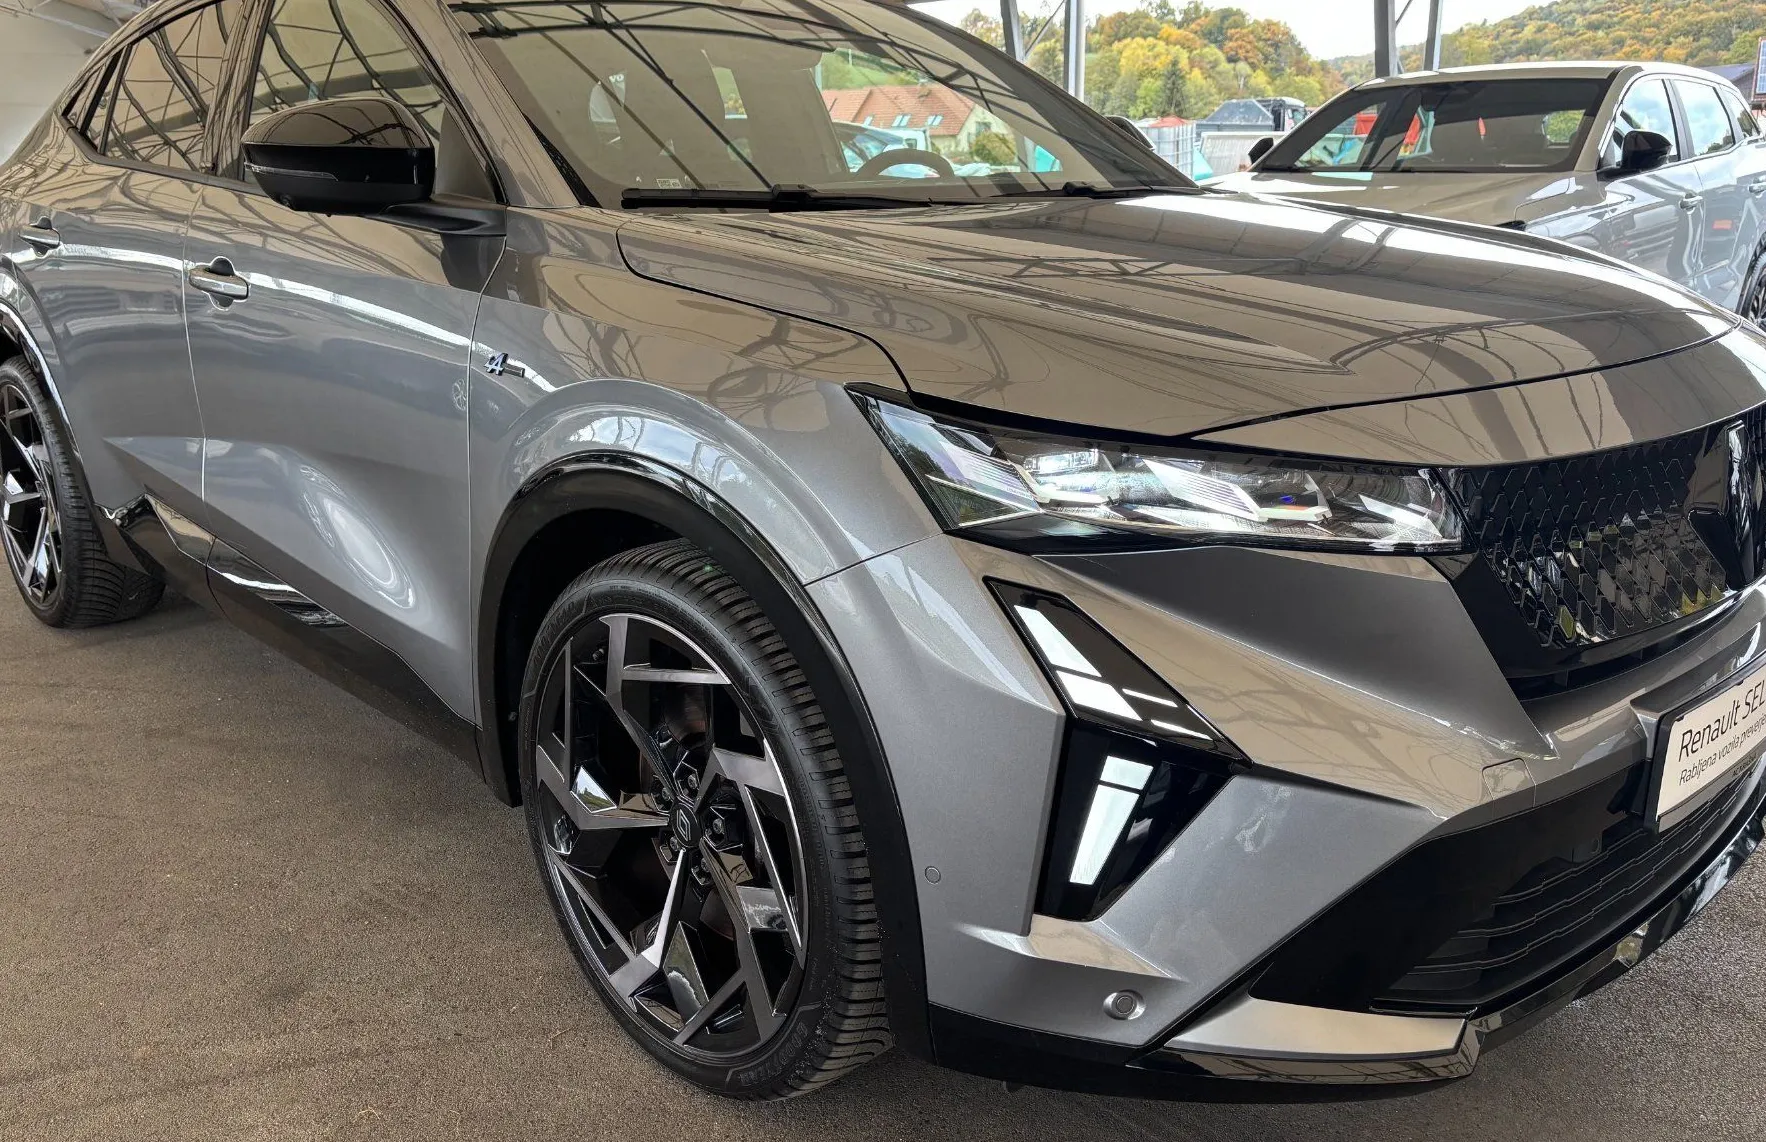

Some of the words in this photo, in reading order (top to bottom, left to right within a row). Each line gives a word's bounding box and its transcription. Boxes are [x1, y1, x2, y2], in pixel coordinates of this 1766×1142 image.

[1679, 700, 1740, 762] Renault
[1742, 680, 1766, 720] SEL
[1679, 753, 1717, 786] Rabljena
